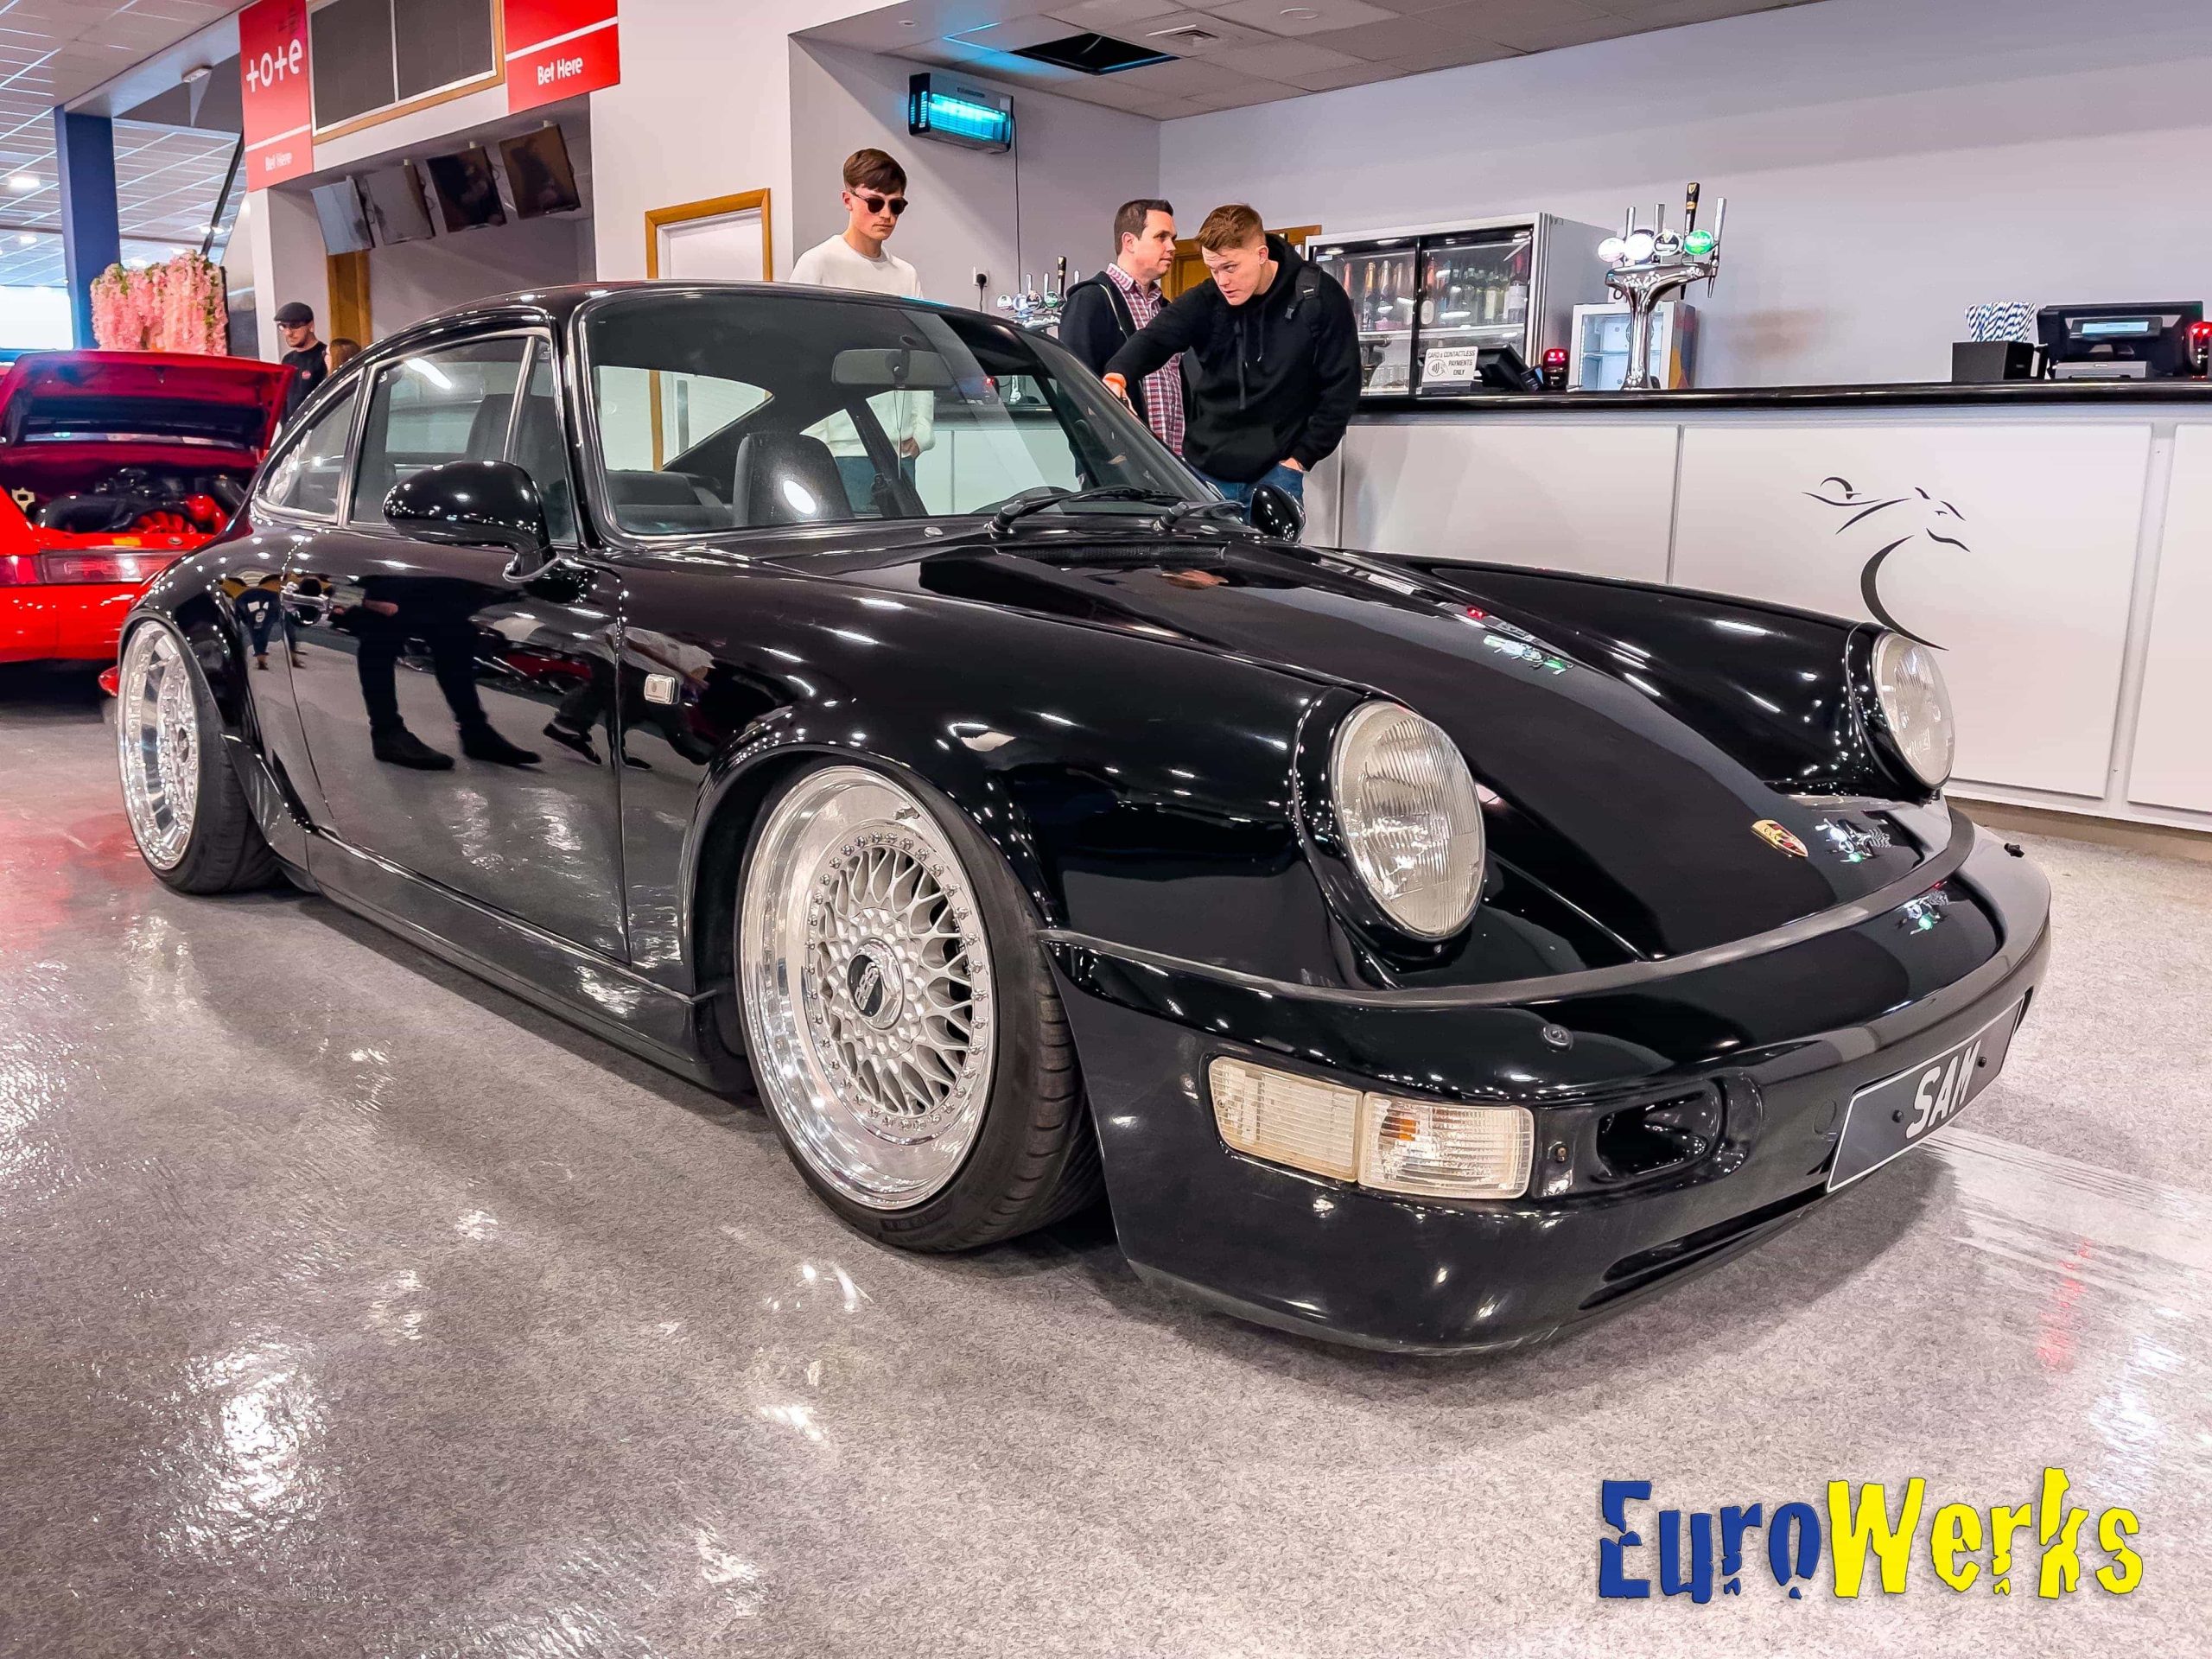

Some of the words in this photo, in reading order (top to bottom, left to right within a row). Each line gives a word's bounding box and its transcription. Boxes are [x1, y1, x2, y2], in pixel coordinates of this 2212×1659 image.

[246, 39, 302, 92] tote
[537, 61, 554, 86] Bet
[556, 57, 583, 79] Here
[1905, 1039, 1981, 1139] SAM
